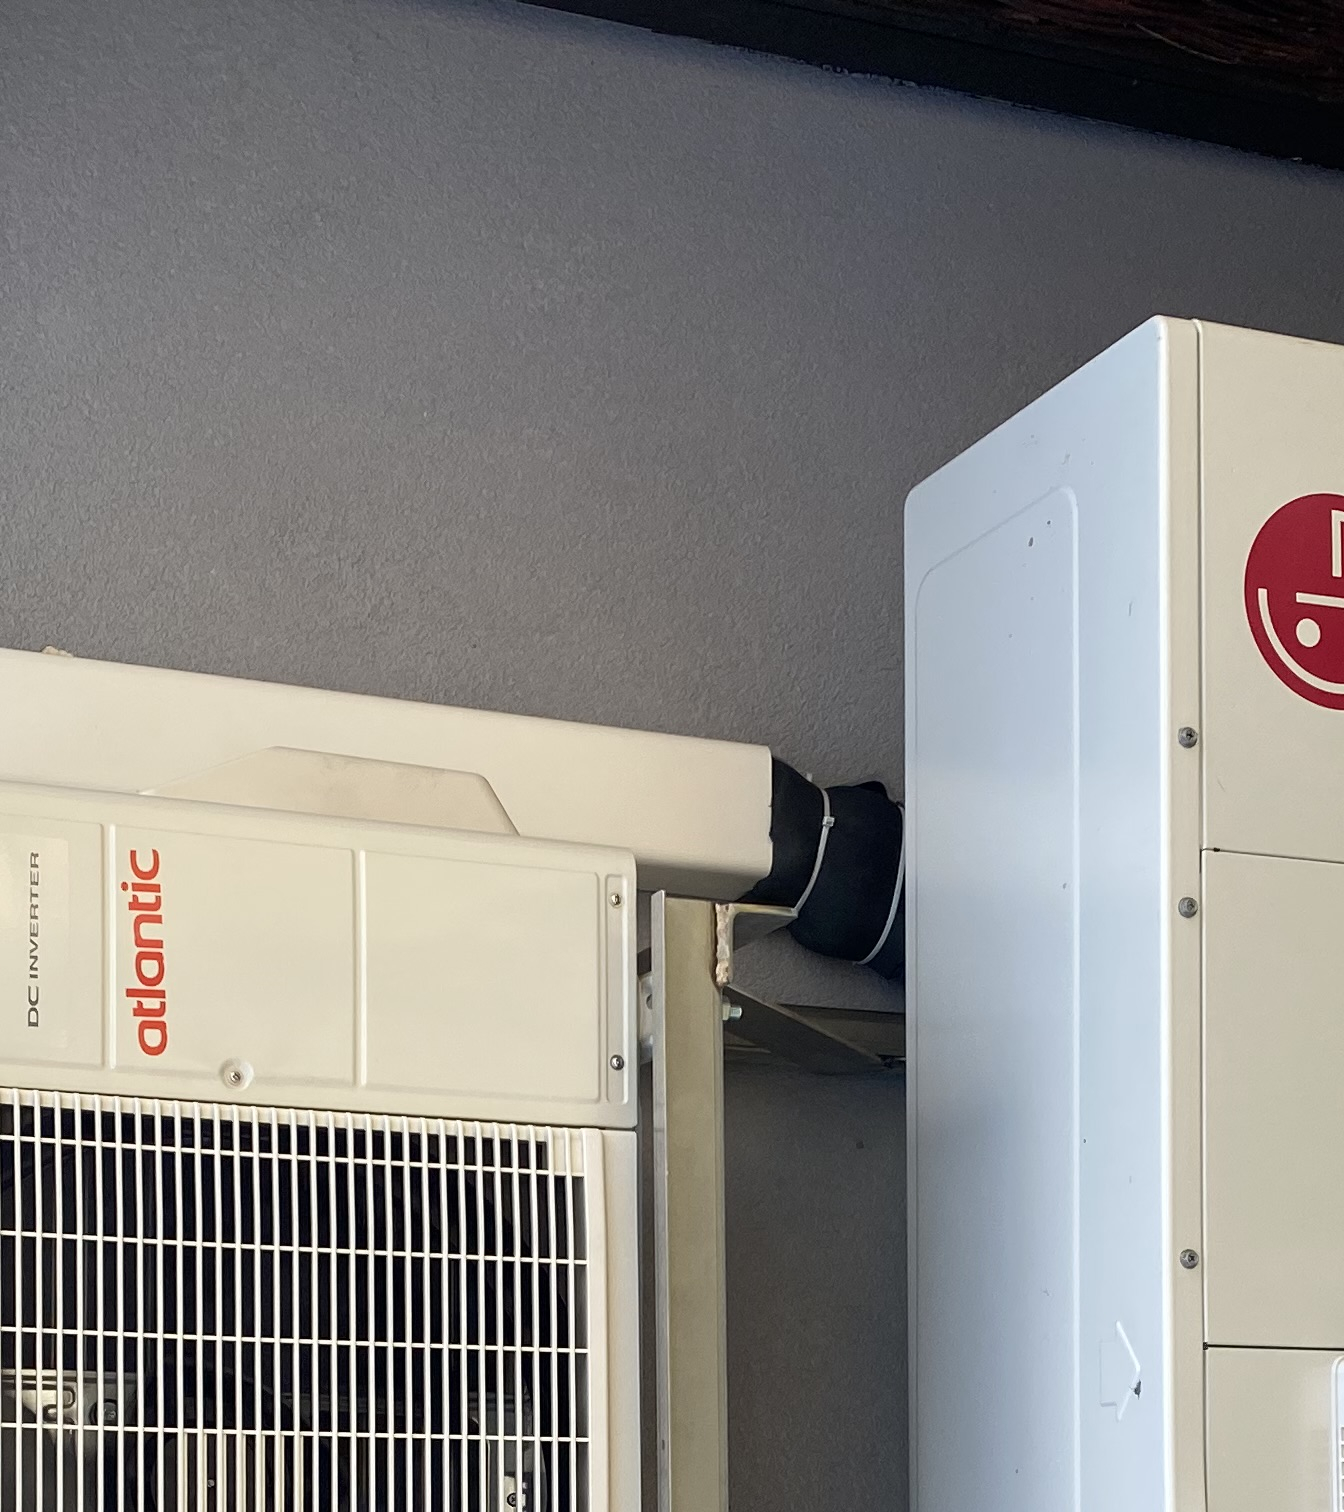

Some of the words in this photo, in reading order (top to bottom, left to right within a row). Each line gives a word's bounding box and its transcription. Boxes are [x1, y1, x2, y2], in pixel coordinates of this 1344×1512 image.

[29, 851, 40, 980] INVERTER
[120, 848, 169, 1057] atlantic
[27, 985, 40, 1028] DC
